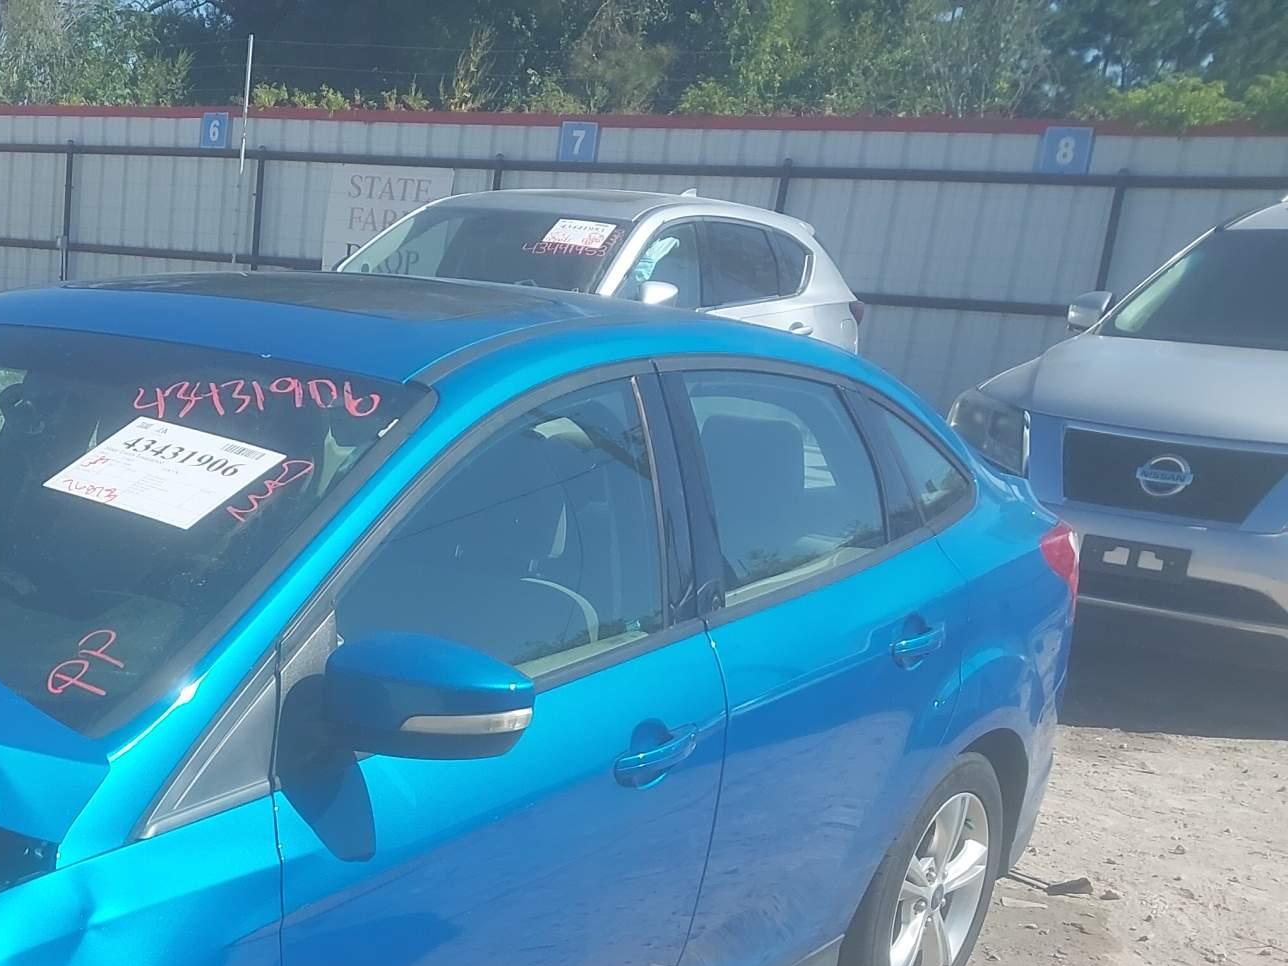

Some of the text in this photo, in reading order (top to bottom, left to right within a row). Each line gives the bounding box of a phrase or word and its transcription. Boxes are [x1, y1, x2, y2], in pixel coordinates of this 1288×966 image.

[208, 120, 220, 141] 6
[571, 129, 585, 155] 7
[1055, 136, 1075, 165] 8
[347, 174, 432, 203] STATE
[347, 206, 411, 232] FAR
[133, 376, 381, 419] 43431906
[123, 437, 248, 477] 43431906
[1140, 469, 1186, 484] NISSAN
